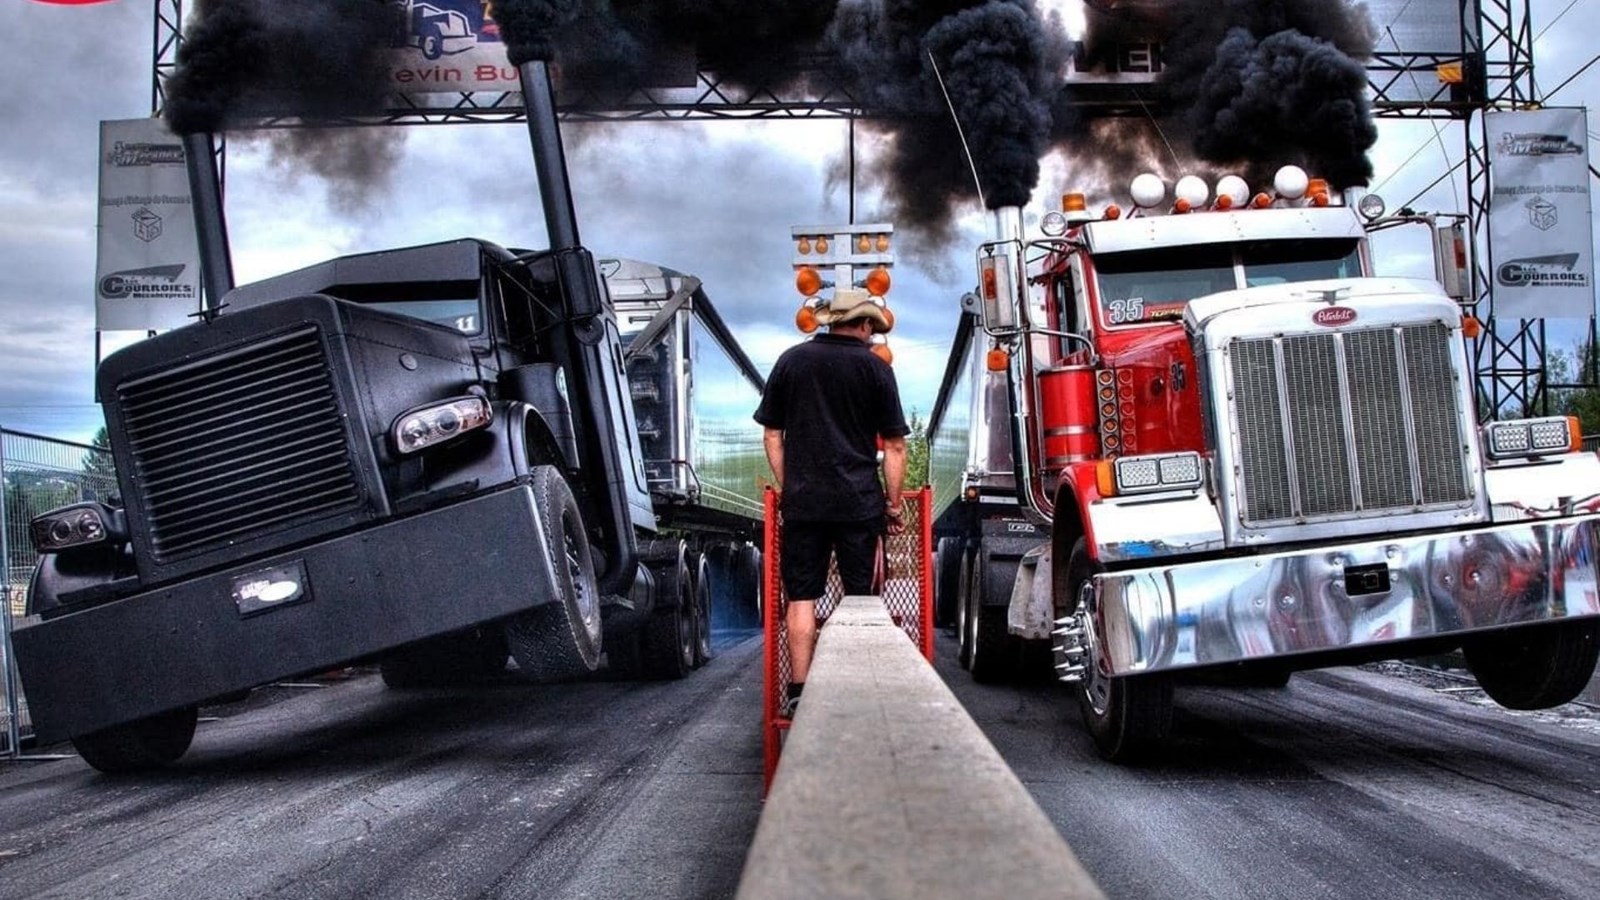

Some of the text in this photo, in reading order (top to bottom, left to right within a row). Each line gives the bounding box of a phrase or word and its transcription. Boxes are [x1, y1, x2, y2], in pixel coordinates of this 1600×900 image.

[393, 65, 461, 82] evin
[103, 276, 192, 294] COURROIES
[1108, 297, 1144, 324] 35
[455, 316, 475, 331] 11
[1171, 361, 1187, 392] 35
